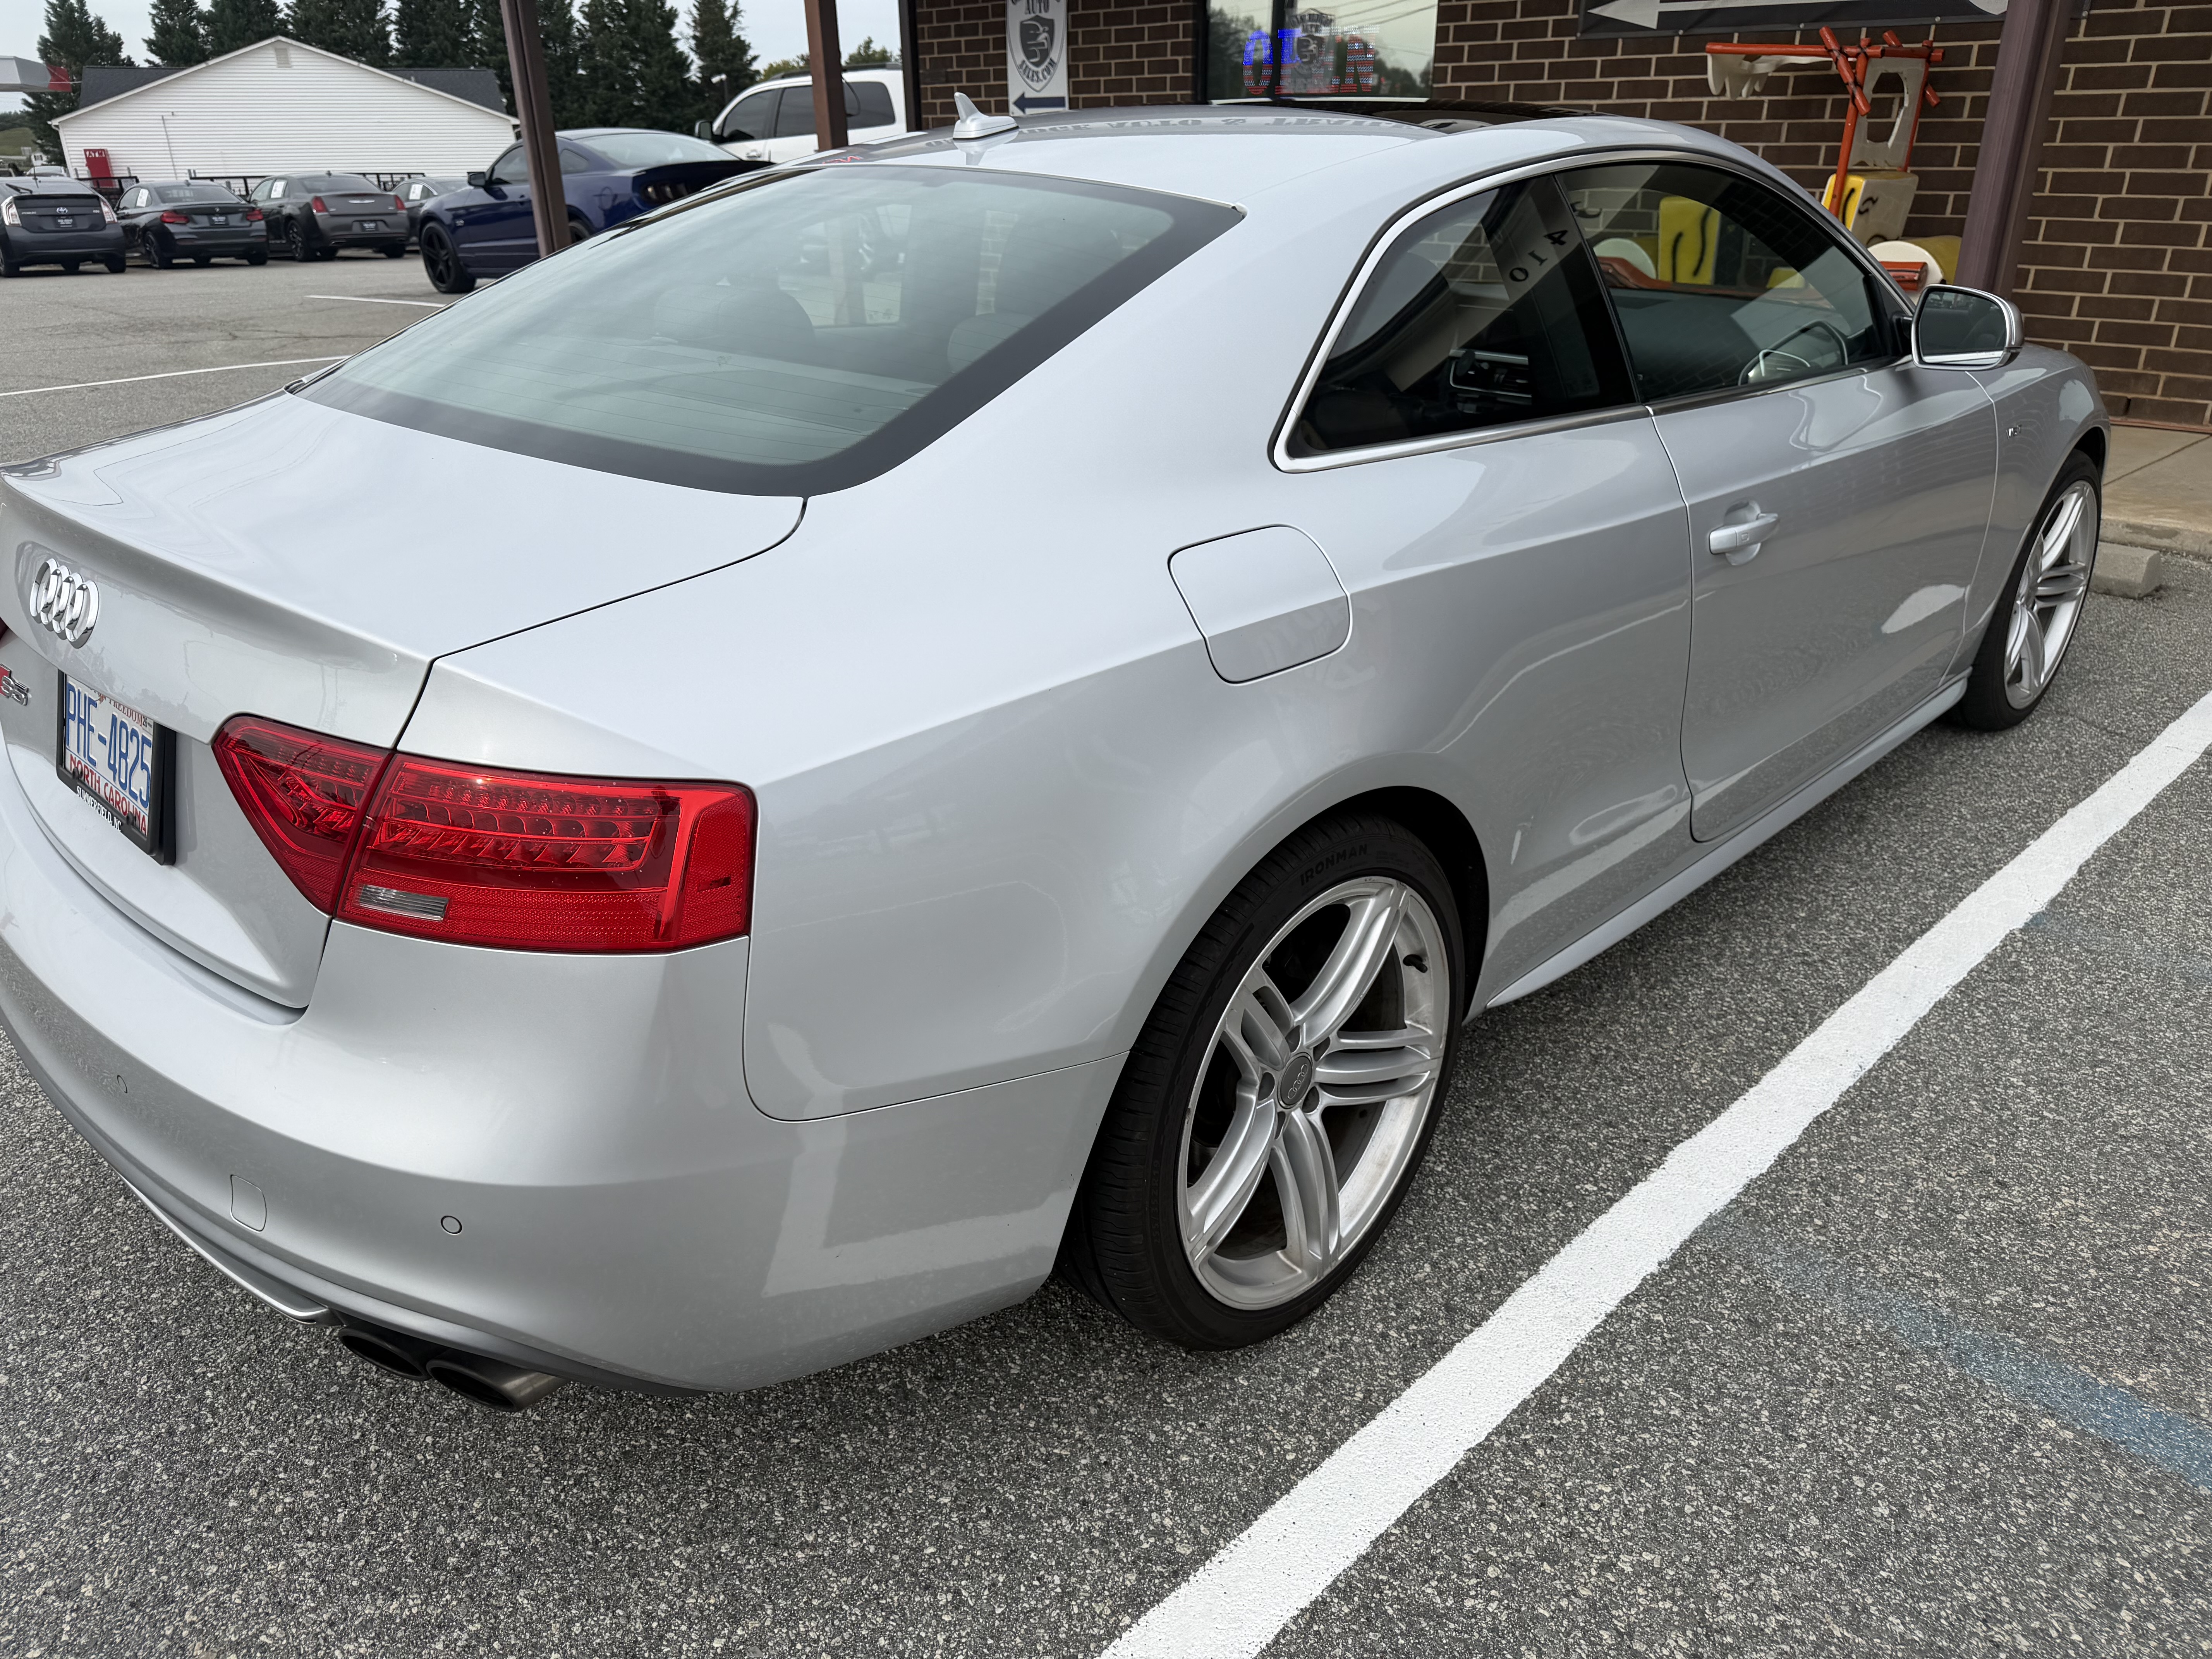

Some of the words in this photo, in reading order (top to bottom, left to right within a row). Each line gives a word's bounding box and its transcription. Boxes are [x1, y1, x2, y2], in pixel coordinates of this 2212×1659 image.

[66, 682, 151, 809] PHE-4825
[70, 754, 101, 794] NORTH
[76, 785, 113, 825] SUMMERFIELD,
[114, 816, 122, 832] NC
[1300, 843, 1368, 886] IRONMAN
